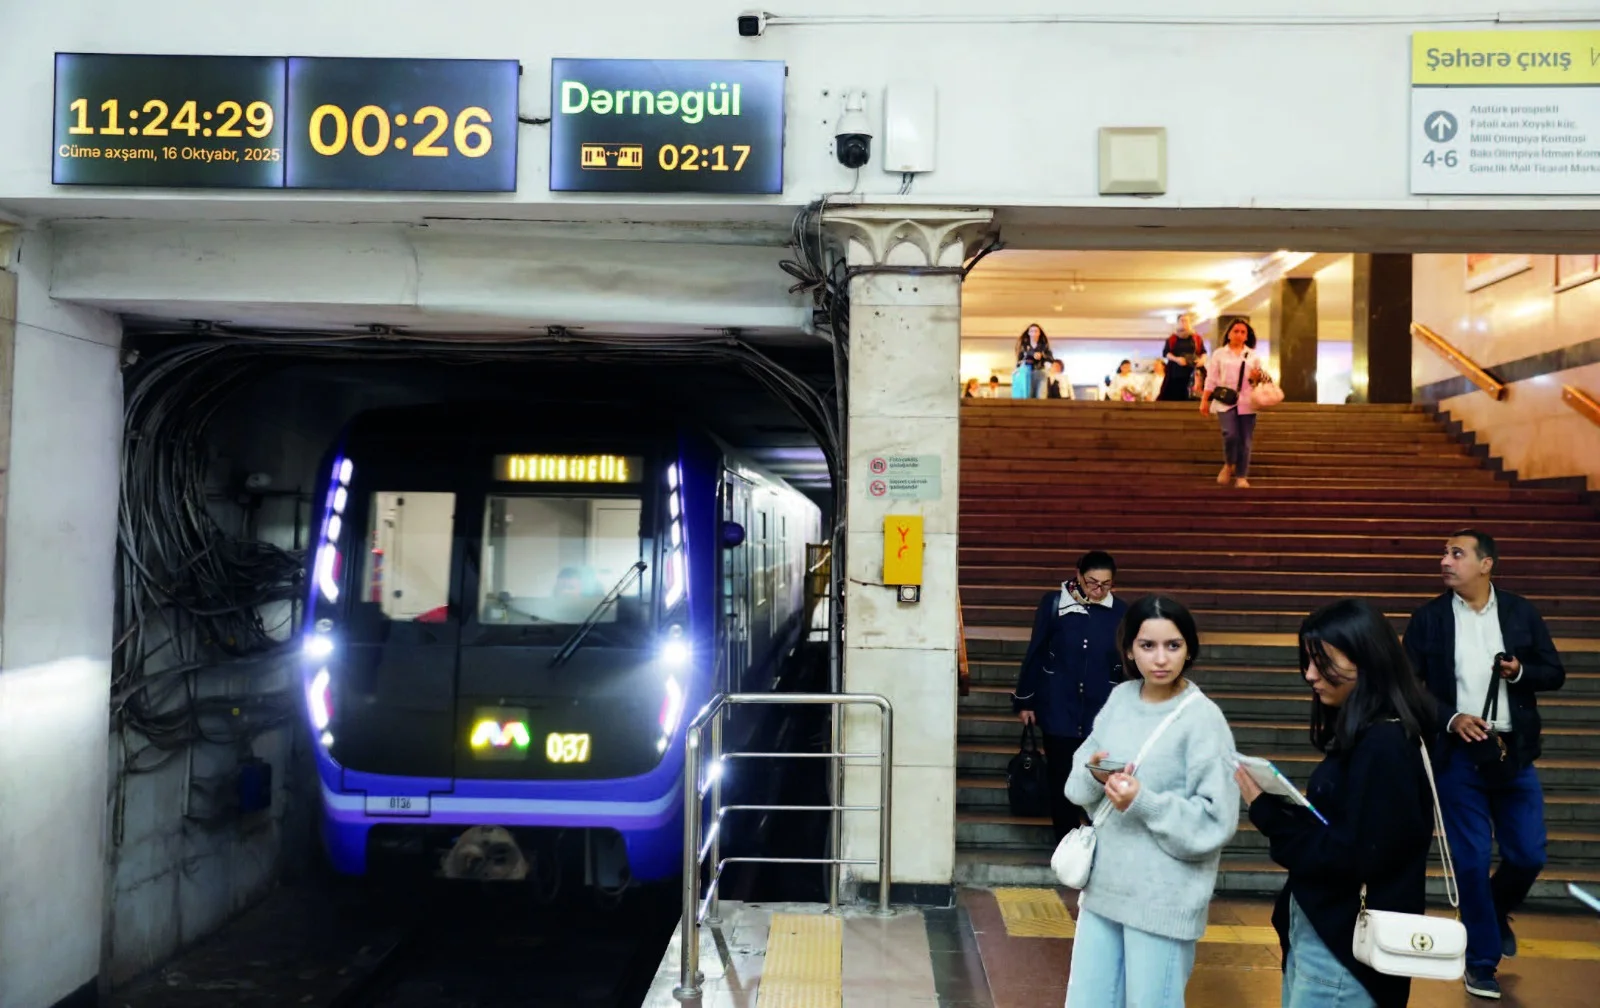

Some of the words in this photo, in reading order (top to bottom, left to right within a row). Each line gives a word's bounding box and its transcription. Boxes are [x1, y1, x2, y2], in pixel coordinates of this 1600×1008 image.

[1426, 48, 1511, 71] Şəhərə
[1517, 52, 1572, 71] çıxış
[560, 80, 742, 124] Dərnəgül
[68, 98, 275, 139] 11:24:29
[308, 103, 494, 159] 00:26
[58, 144, 101, 158] Cümə
[104, 146, 158, 162] axşamı,
[163, 147, 178, 160] 16
[181, 147, 240, 163] Oktyabr,
[244, 148, 281, 161] 2025
[658, 143, 751, 171] 02:17
[1422, 149, 1458, 168] 4-6
[545, 732, 591, 763] 037
